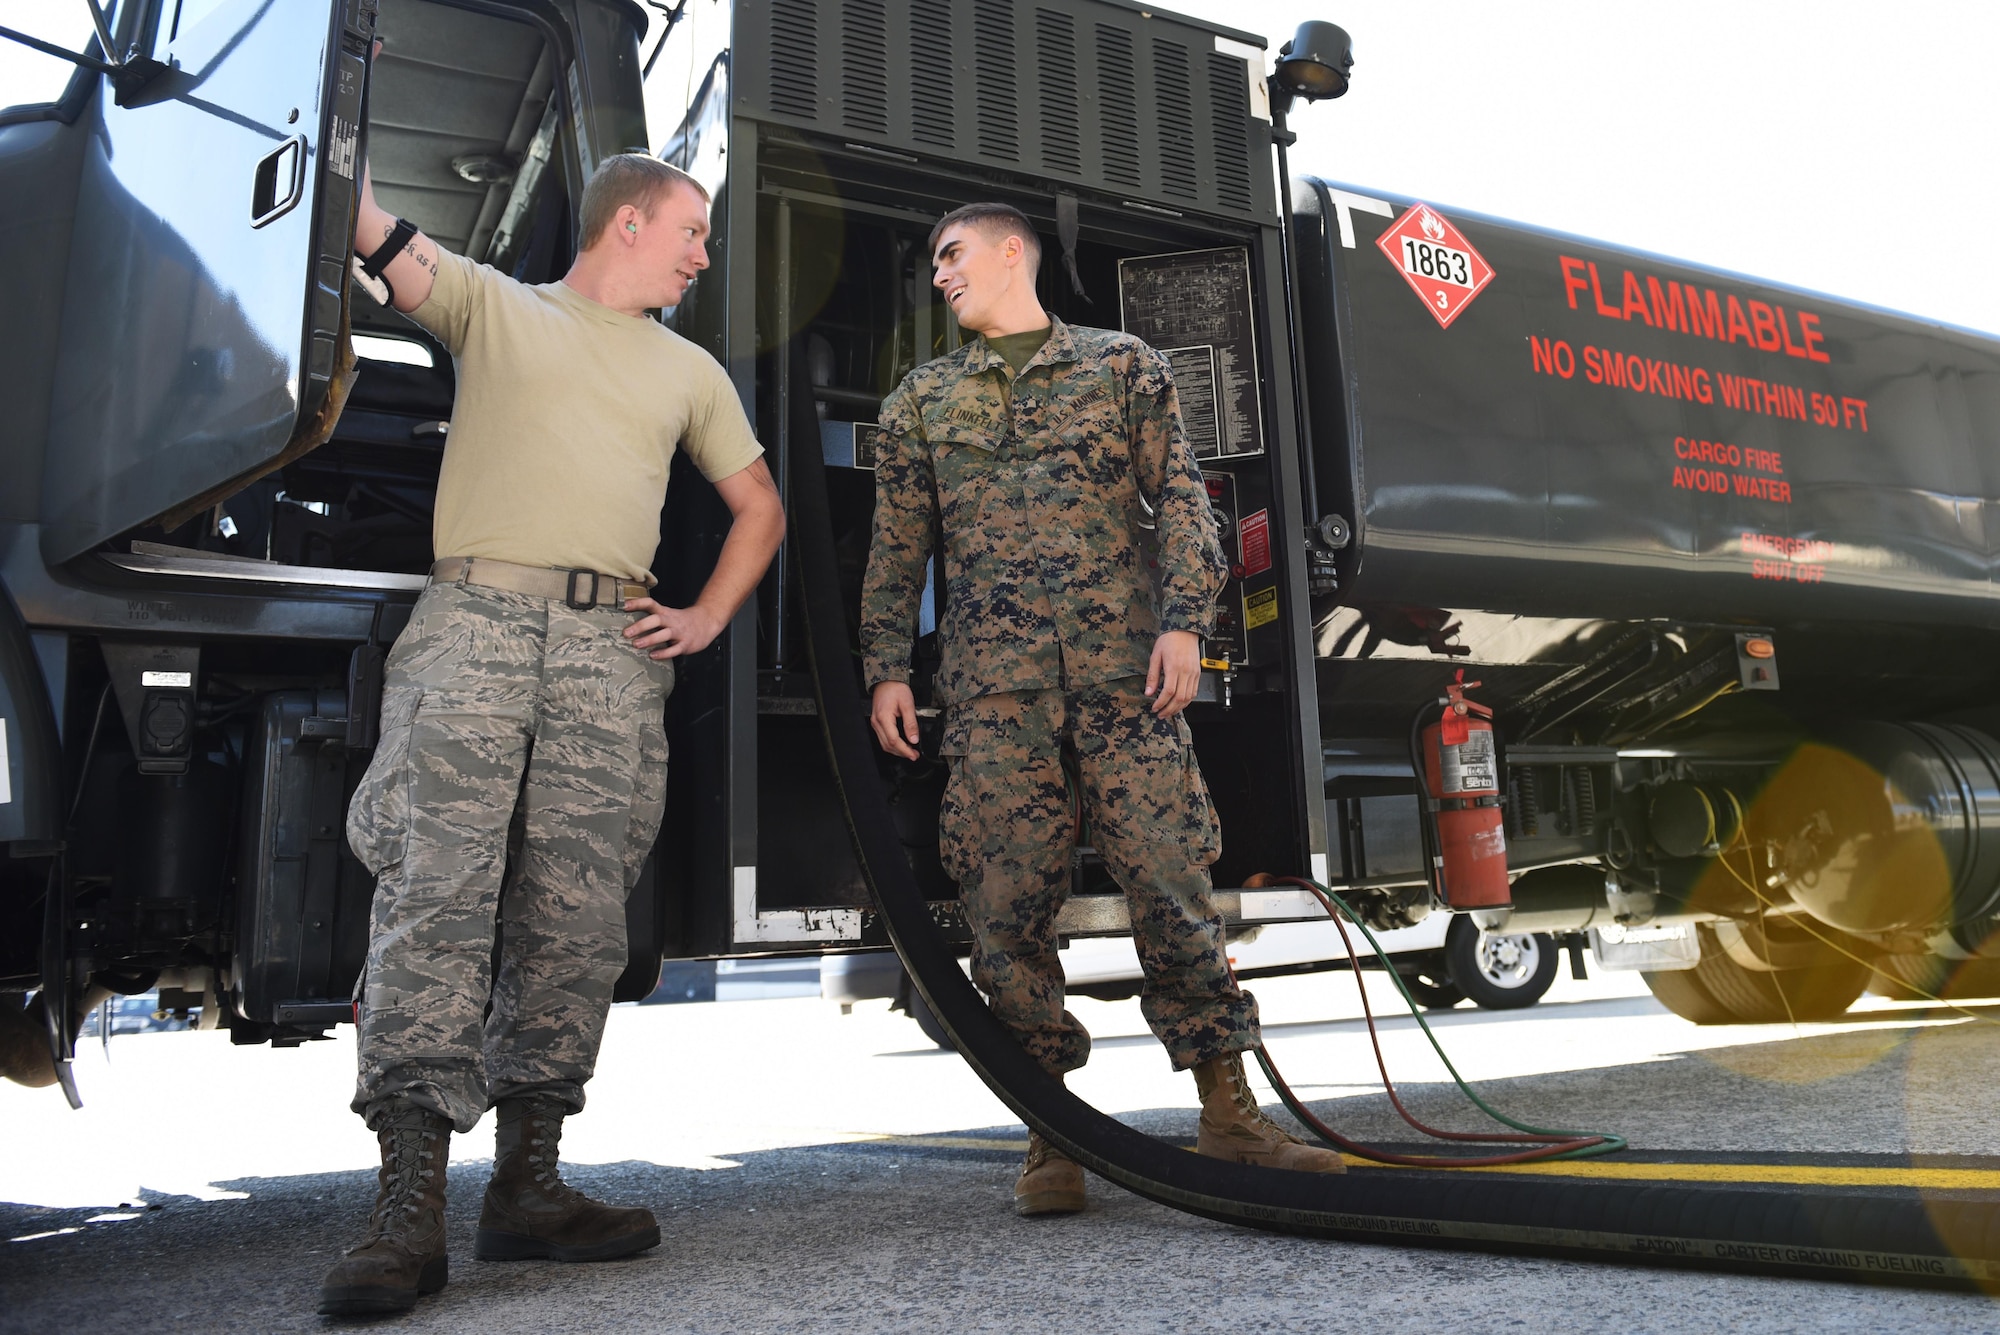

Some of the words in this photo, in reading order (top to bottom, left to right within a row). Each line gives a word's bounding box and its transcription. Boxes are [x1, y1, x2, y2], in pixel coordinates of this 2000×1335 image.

[1406, 240, 1468, 285] 1863
[1436, 290, 1449, 309] 3
[1559, 255, 1831, 364] FLAMMABLE
[1530, 335, 1575, 379] NO
[1583, 345, 1714, 405] SMOKING
[1716, 372, 1807, 421] WITHIN
[1811, 392, 1839, 427] 50
[1841, 396, 1868, 432] FT
[1070, 387, 1107, 409] MARINES
[944, 406, 1002, 431] FLINKFELT
[1674, 436, 1741, 467] CARGO
[1744, 447, 1783, 474] FIRE
[1672, 466, 1729, 494] AVOID
[1732, 473, 1792, 503] WATER
[1246, 513, 1266, 529] CAUTION
[1741, 532, 1835, 560] EMERGENCY
[1752, 558, 1793, 582] SHUT
[1796, 563, 1826, 584] OFF
[1248, 592, 1273, 606] CAUTION
[128, 611, 149, 620] 110
[1294, 1212, 1337, 1228] CARTER
[1339, 1216, 1388, 1231] GROUND
[1389, 1220, 1440, 1235] FUELING
[1714, 1242, 1781, 1262] CARTER
[1786, 1248, 1860, 1268] GROUND
[1864, 1253, 1945, 1275] FUELING
